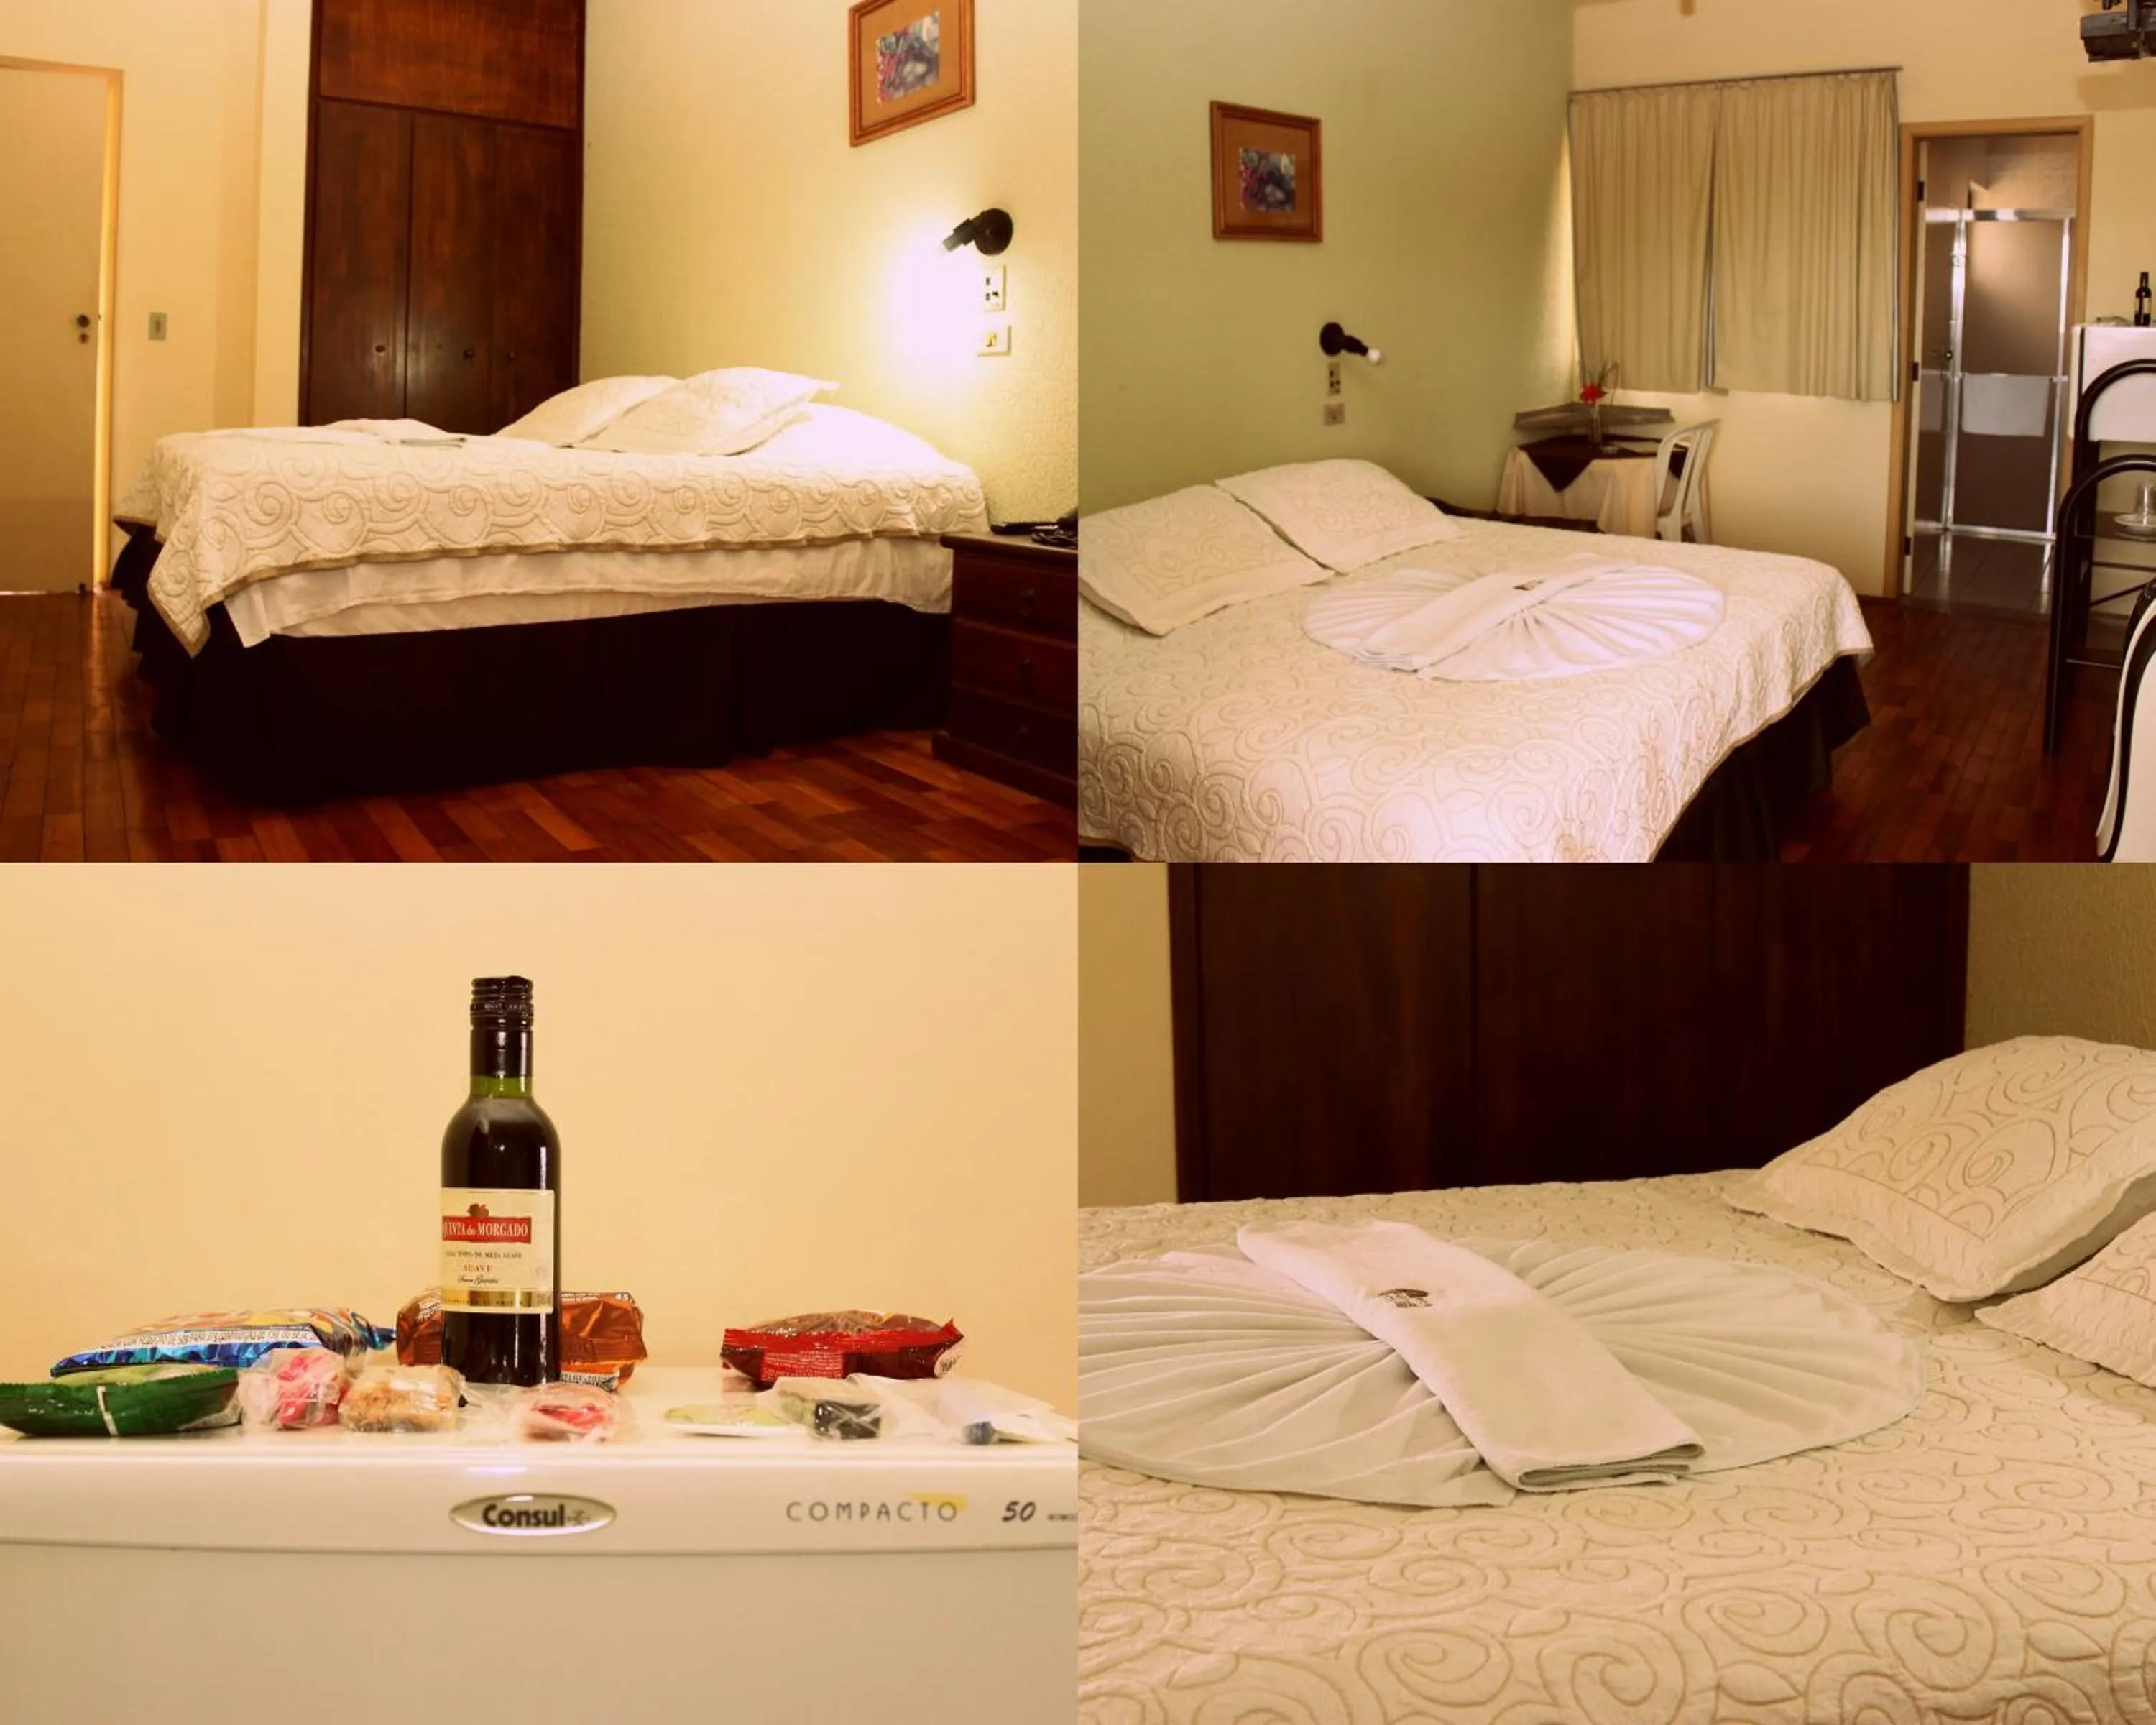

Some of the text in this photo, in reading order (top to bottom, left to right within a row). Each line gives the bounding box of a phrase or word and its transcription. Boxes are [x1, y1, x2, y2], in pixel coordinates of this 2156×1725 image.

[477, 1222, 528, 1236] MORGADO
[482, 1503, 566, 1527] Consul
[786, 1501, 958, 1522] COMPACTO
[1002, 1500, 1036, 1523] 50
